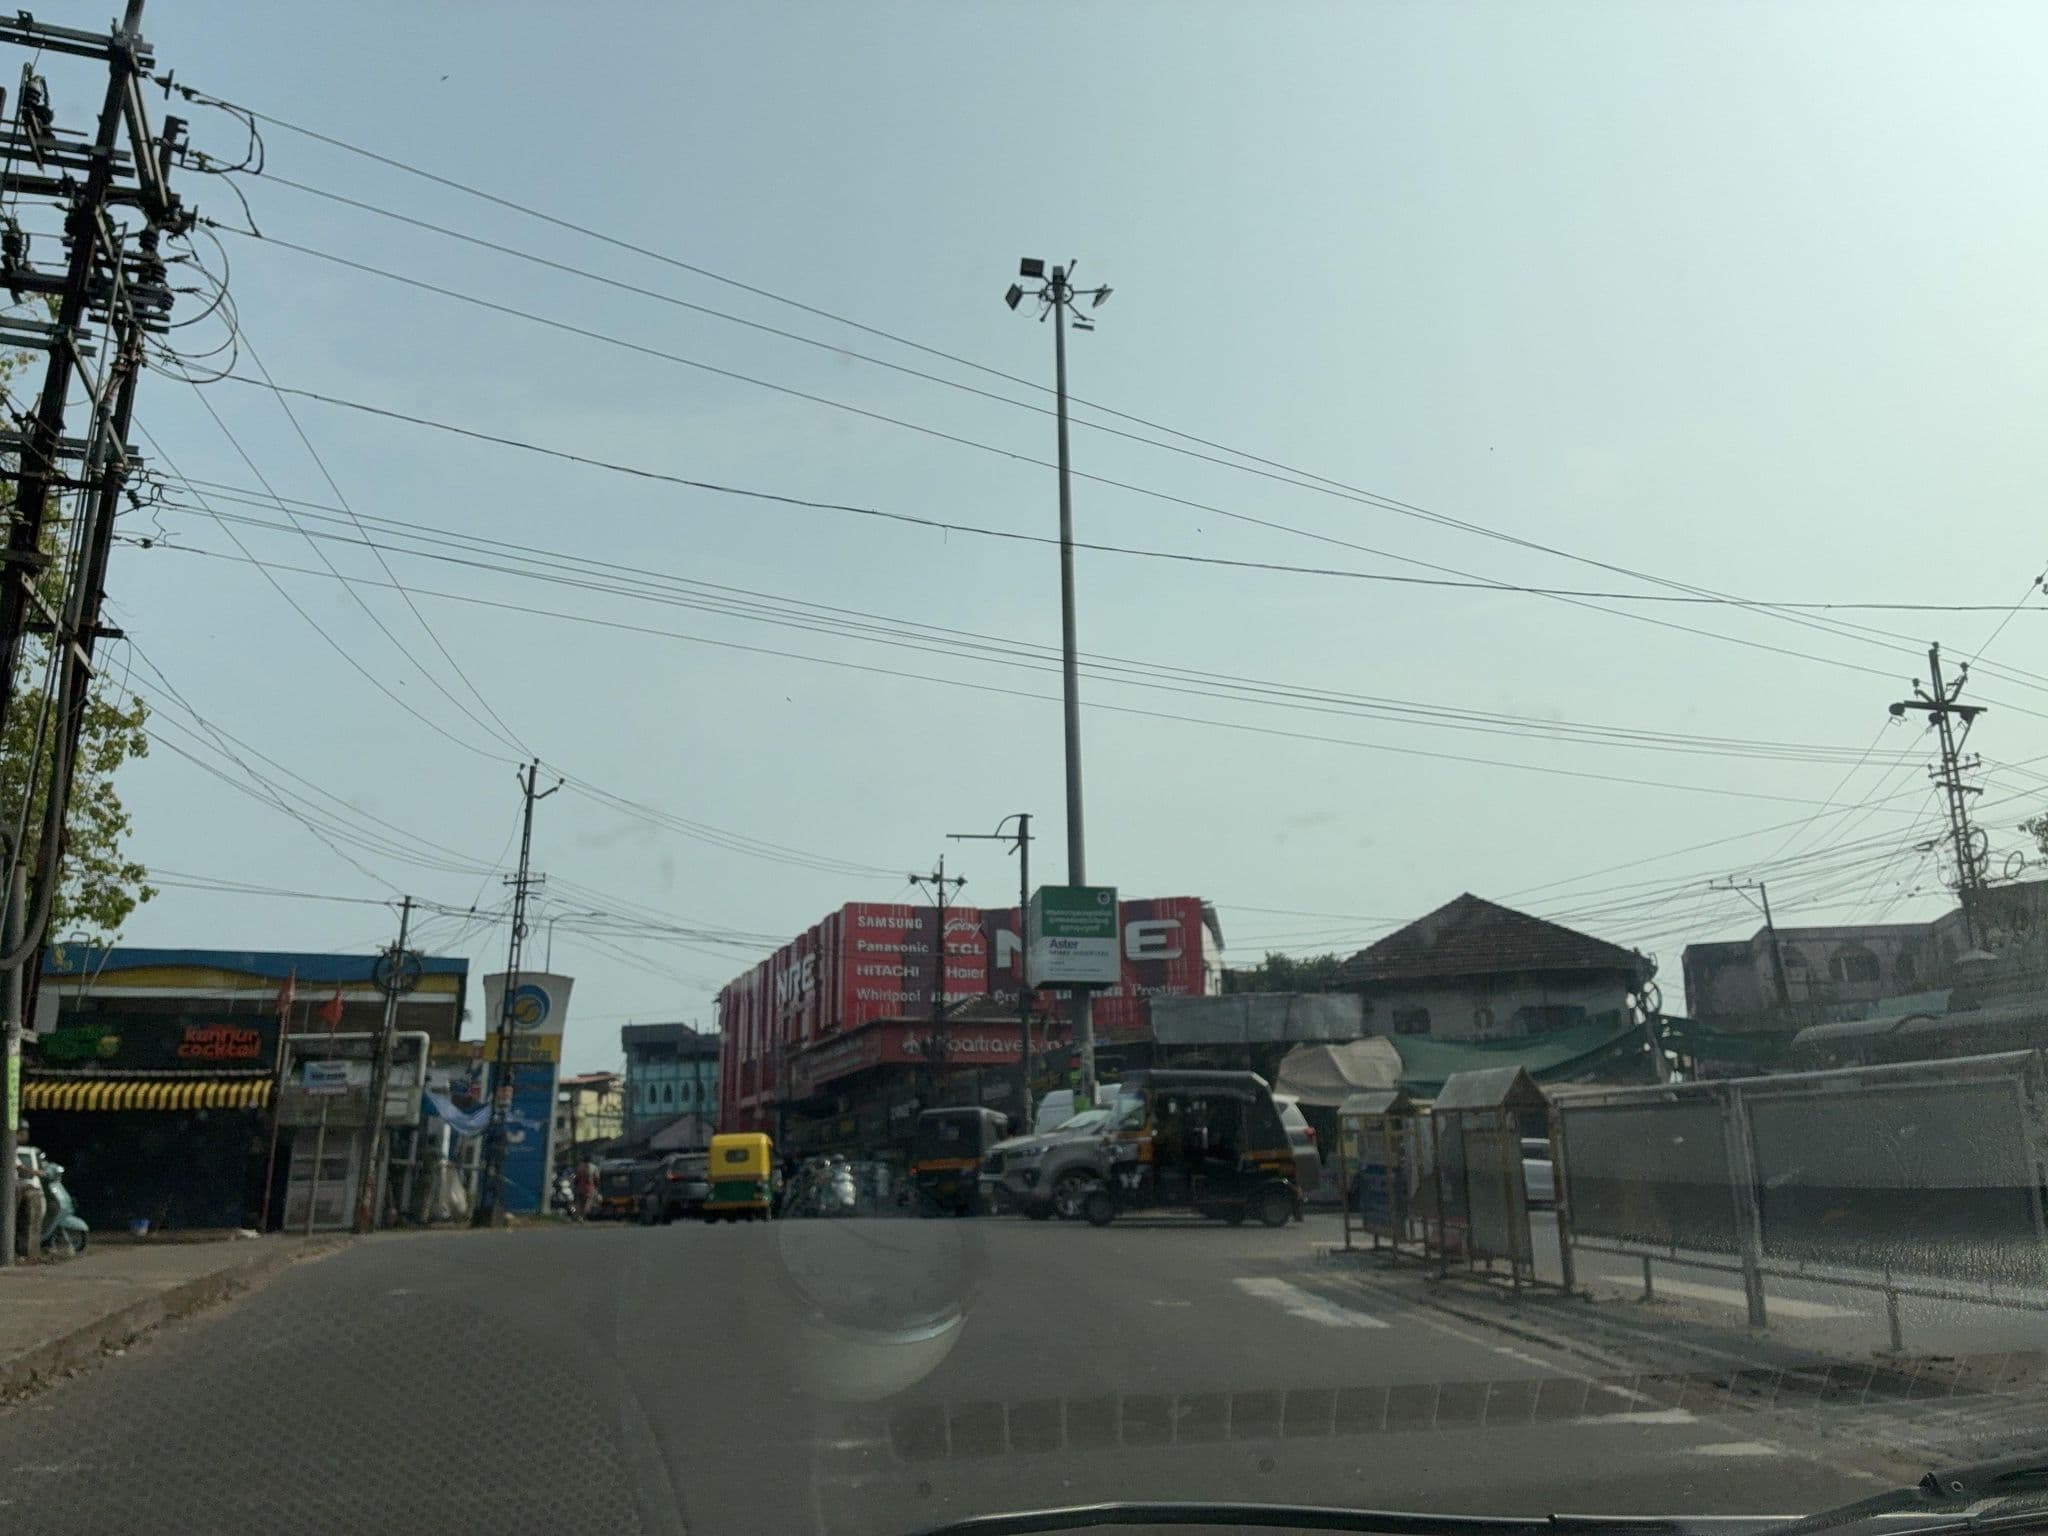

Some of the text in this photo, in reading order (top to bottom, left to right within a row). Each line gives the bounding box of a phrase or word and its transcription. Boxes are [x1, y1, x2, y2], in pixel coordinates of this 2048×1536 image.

[857, 915, 923, 929] SAMSUNG
[856, 939, 929, 953] Panasonic
[945, 943, 985, 955] TCL
[1049, 939, 1078, 949] Aster
[856, 964, 920, 977] HITACHI
[945, 965, 985, 979] Haier
[856, 987, 921, 1002] Whirlpool
